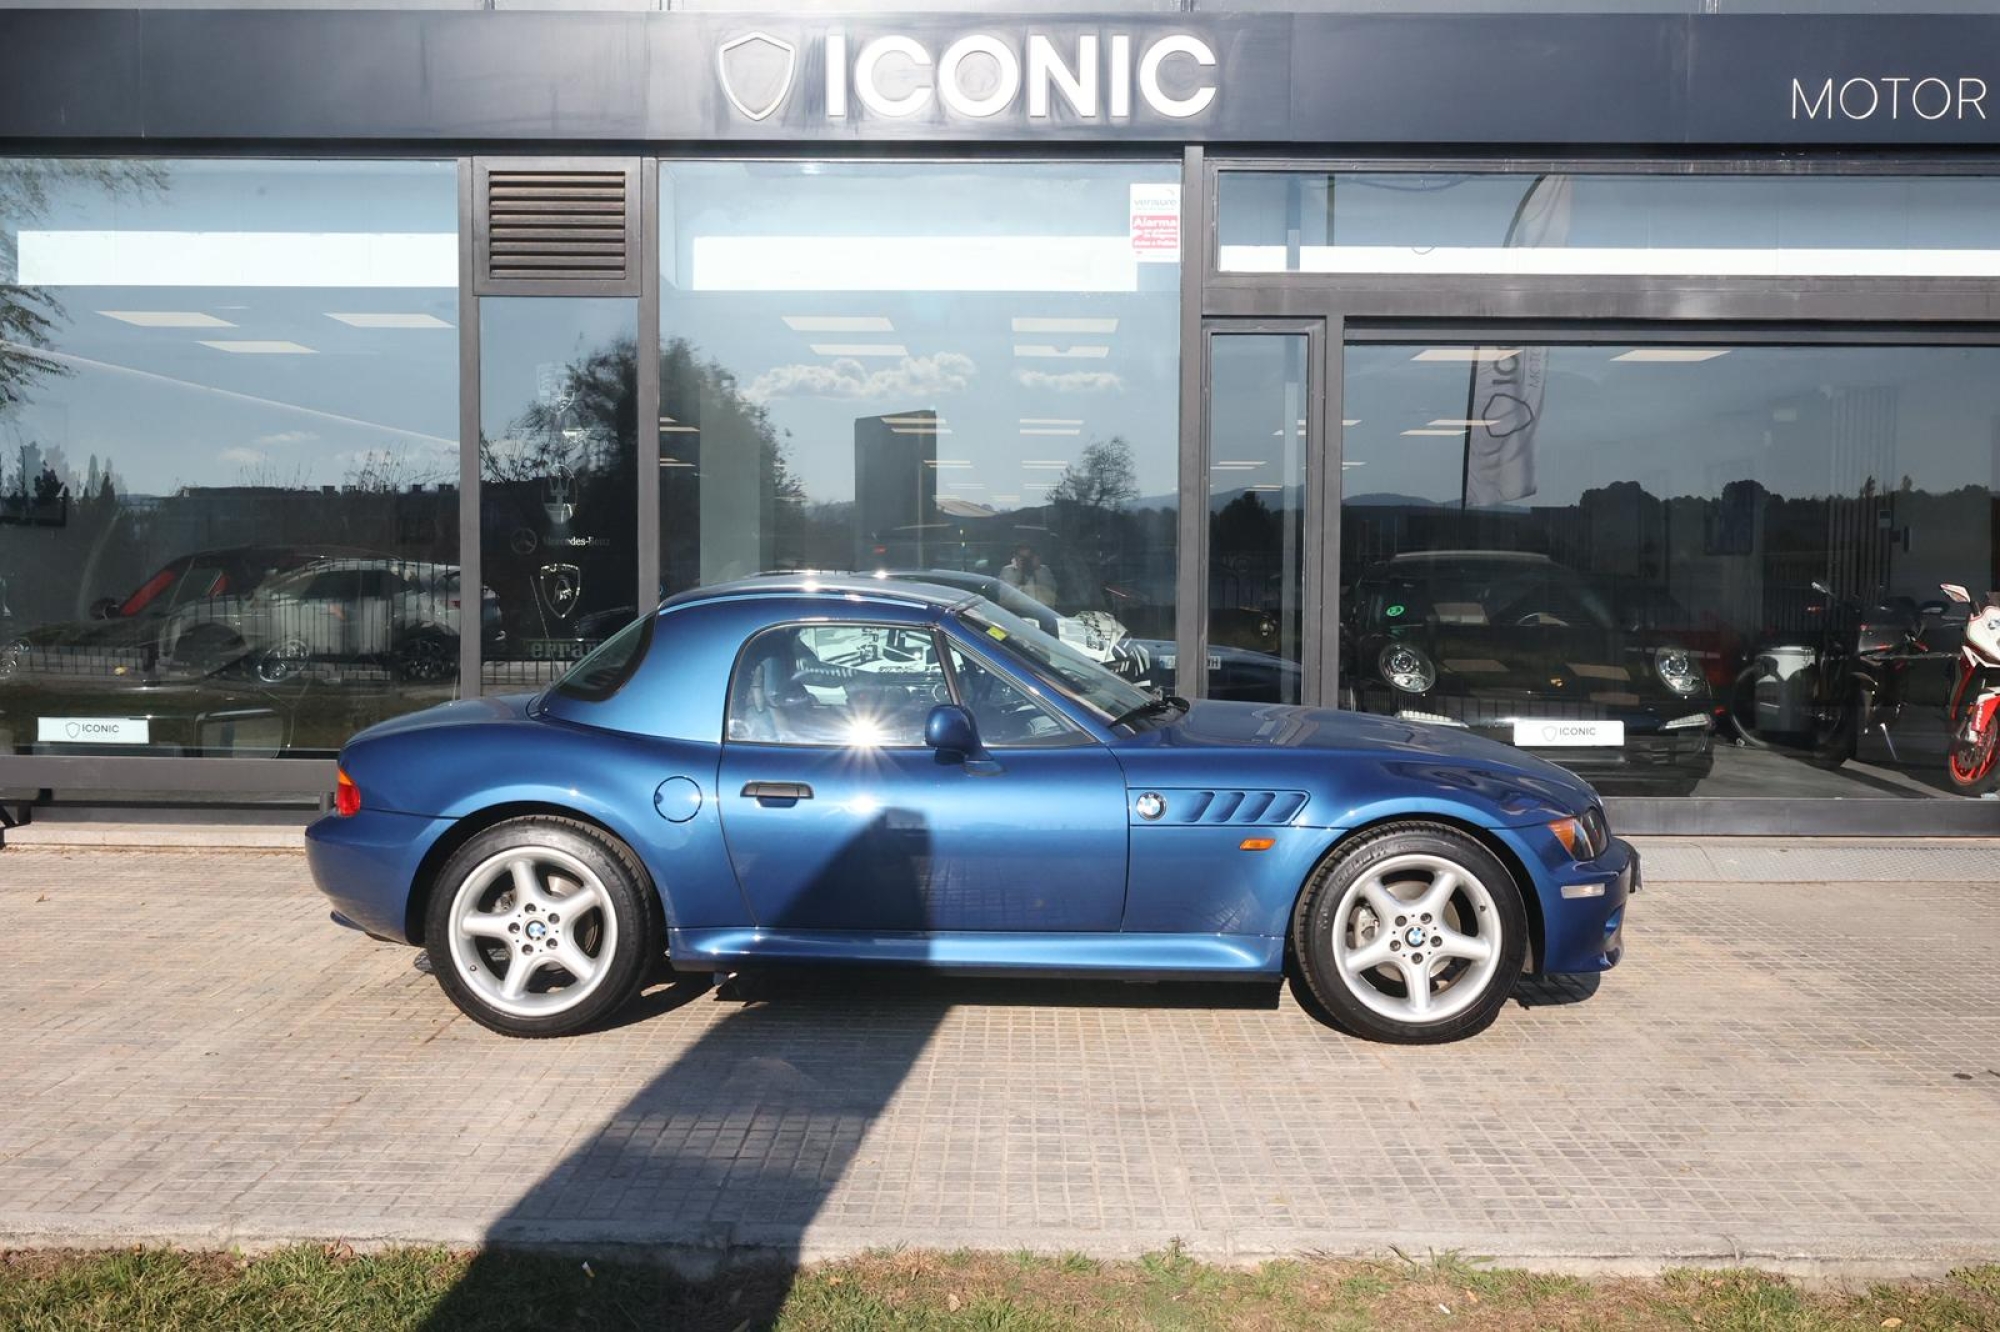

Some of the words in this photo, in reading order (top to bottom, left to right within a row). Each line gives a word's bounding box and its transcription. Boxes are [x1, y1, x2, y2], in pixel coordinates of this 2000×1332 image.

[827, 34, 1217, 118] ICONIC
[1791, 77, 1987, 120] MOTOR
[1133, 217, 1177, 227] Alarma
[82, 724, 120, 733] ICONIC
[1559, 727, 1596, 736] ICONIC
